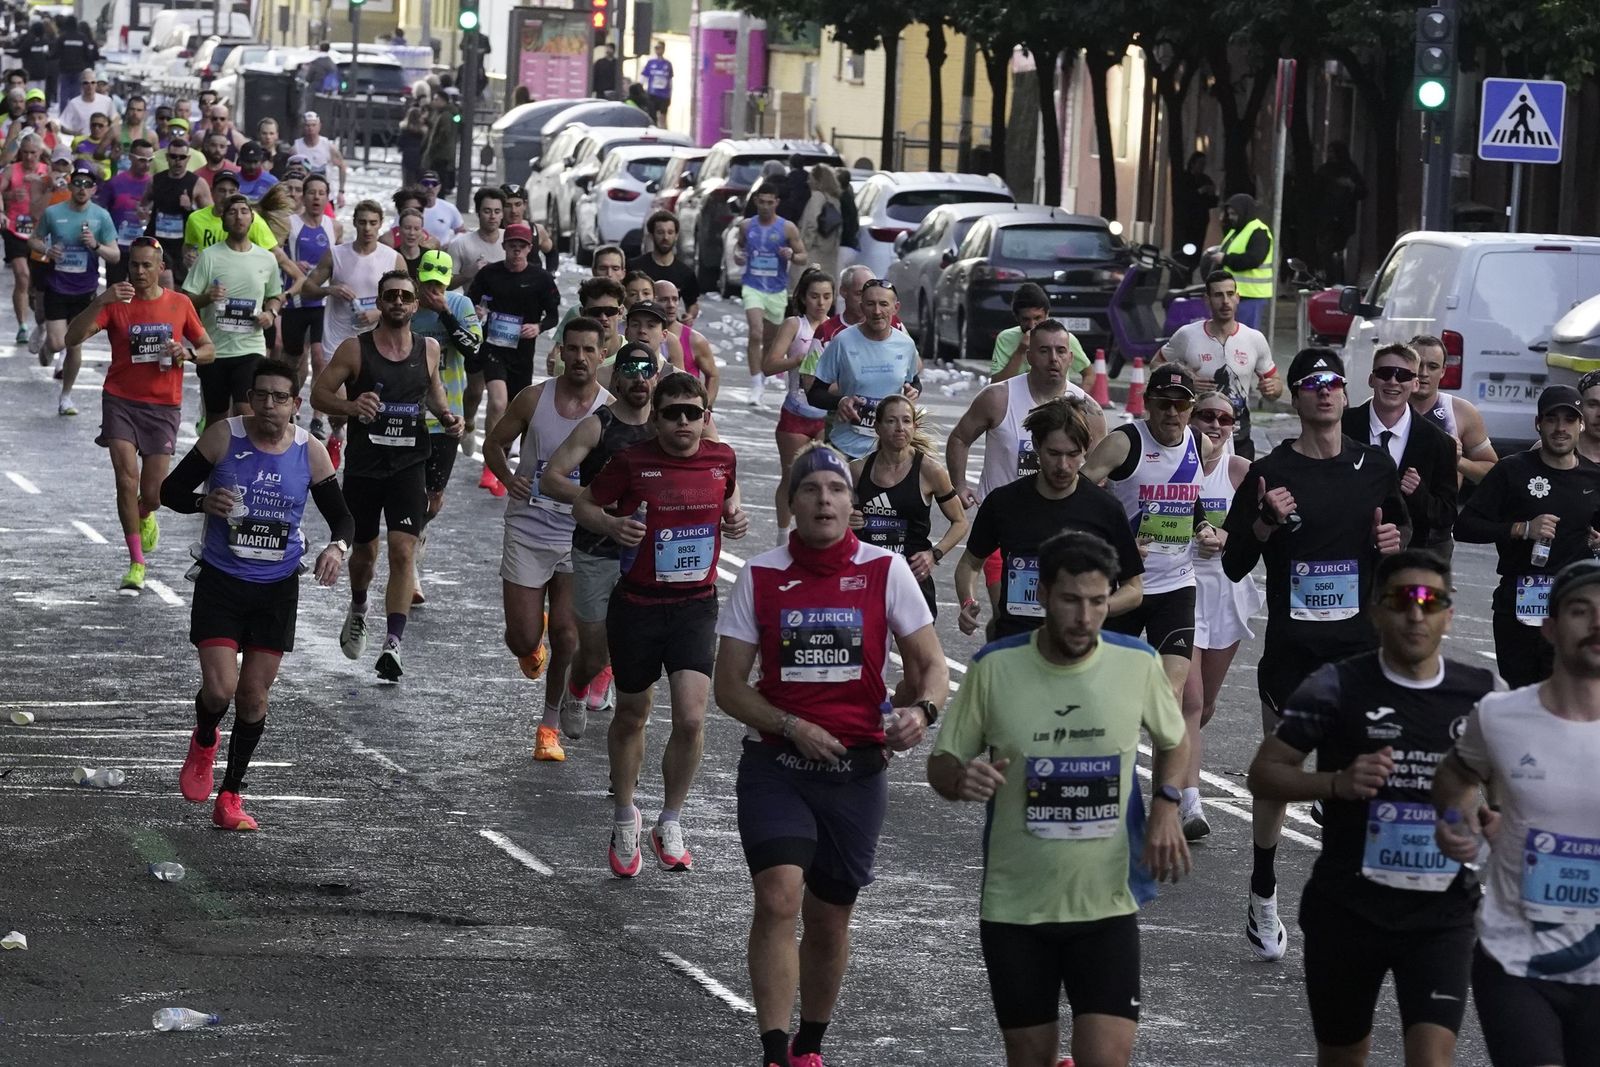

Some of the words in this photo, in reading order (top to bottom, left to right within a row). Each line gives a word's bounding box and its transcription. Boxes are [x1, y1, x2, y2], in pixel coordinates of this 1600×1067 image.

[1487, 384, 1520, 398] 9177
[1525, 386, 1547, 399] MF
[388, 405, 415, 413] ZURICH
[384, 426, 403, 436] ANT
[253, 509, 285, 519] ZURICH
[862, 506, 897, 516] adidas
[1163, 506, 1191, 514] ZURICH
[251, 524, 270, 534] 4772
[1161, 521, 1178, 529] 2449
[676, 527, 709, 538] ZURICH
[236, 532, 280, 549] MARTÍN
[677, 545, 696, 554] 8932
[674, 556, 701, 569] JEFF
[1313, 564, 1350, 573] ZURICH
[1314, 582, 1334, 591] 5560
[1305, 593, 1344, 606] FREDY
[808, 612, 853, 623] ZURICH
[809, 634, 834, 645] 4720
[794, 649, 849, 665] SERGIO
[1060, 761, 1111, 773] ZURICH
[1061, 785, 1089, 798] 3840
[1027, 805, 1072, 820] SUPER
[1075, 803, 1119, 820] SILVER
[1379, 849, 1447, 869] GALLUD
[1544, 883, 1599, 904] LOUIS
